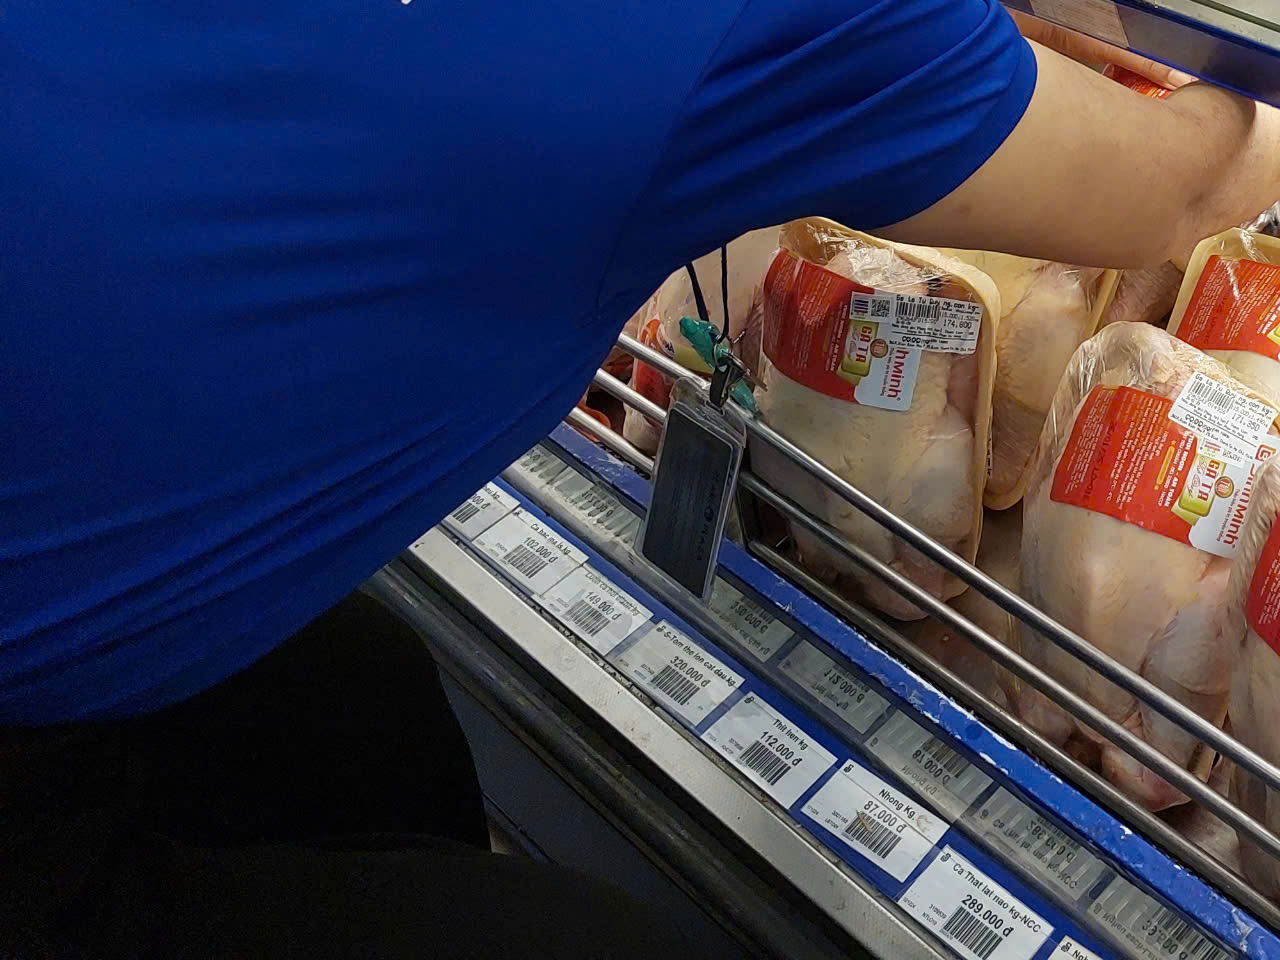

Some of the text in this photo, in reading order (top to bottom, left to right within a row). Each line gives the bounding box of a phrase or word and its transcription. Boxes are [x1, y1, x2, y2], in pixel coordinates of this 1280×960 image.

[1197, 482, 1213, 502] TA
[523, 536, 559, 564] 102.000 đ
[584, 590, 622, 621] 149.000 đ
[682, 643, 694, 656] the
[669, 655, 711, 688] 320.000 đ
[759, 730, 803, 768] 112.000 đ
[799, 739, 809, 751] kg
[863, 800, 908, 834] 87.000 đ
[878, 788, 917, 821] Nhong Kg.
[952, 863, 1042, 934] Ca That lat nao kg-NCC
[961, 893, 1015, 938] 289.000 đ
